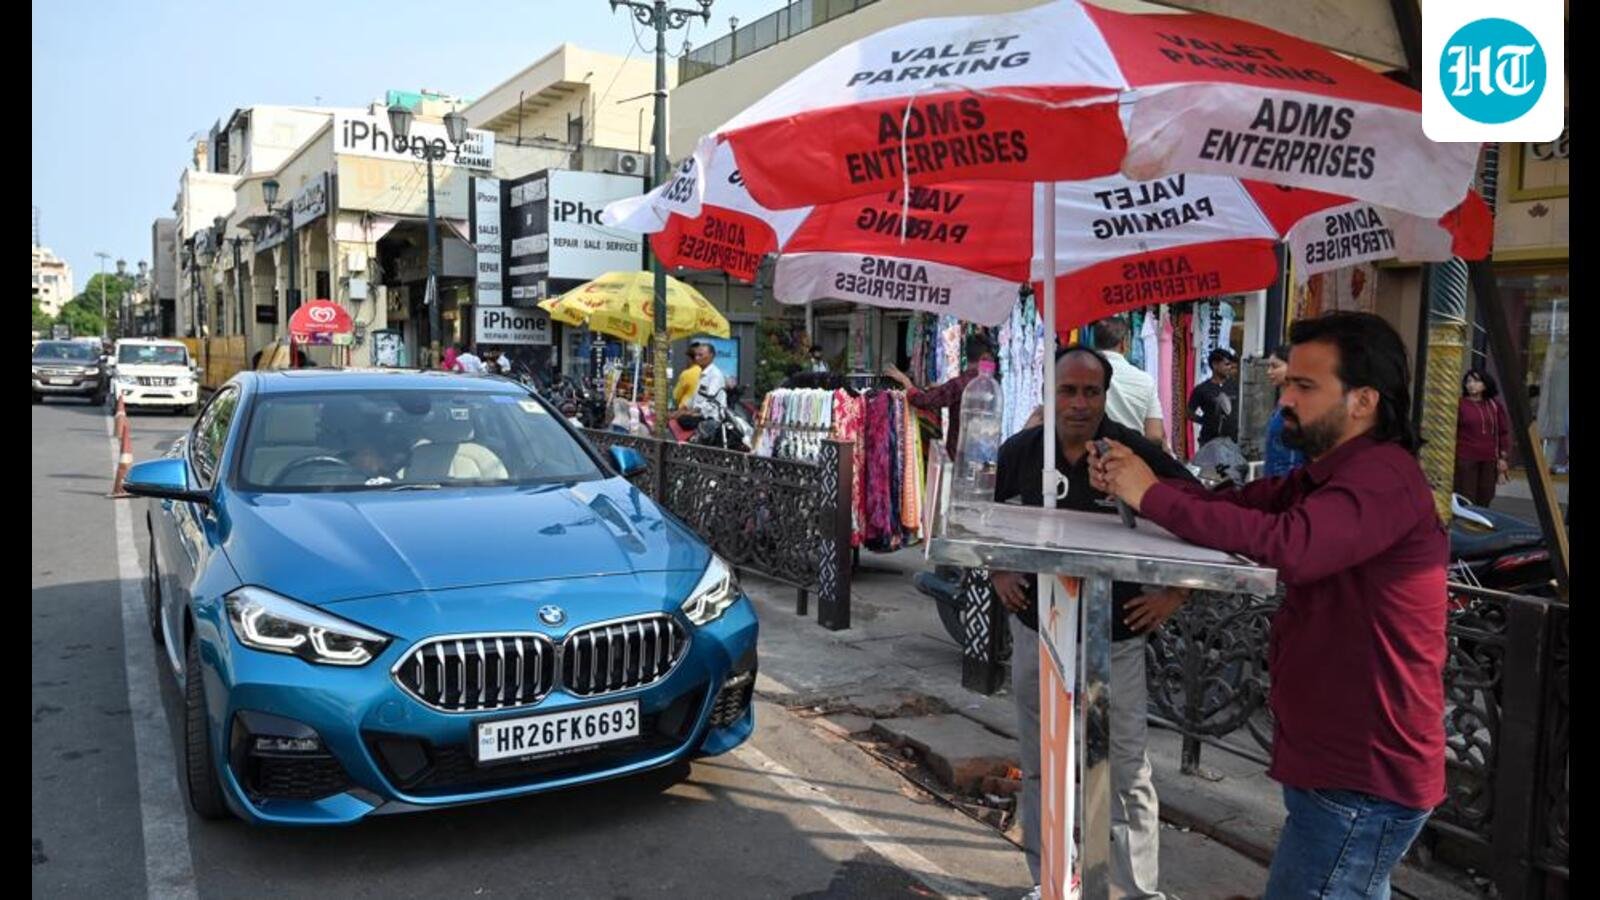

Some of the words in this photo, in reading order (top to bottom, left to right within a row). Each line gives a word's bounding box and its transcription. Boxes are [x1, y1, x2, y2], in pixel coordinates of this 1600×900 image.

[846, 52, 1031, 87] PARKING
[891, 35, 1019, 64] VALET
[877, 98, 986, 144] ADMS
[1249, 98, 1355, 140] ADMS
[846, 129, 1029, 184] ENTERPRISES
[1199, 128, 1376, 180] ENTERPRISES
[554, 237, 578, 248] REPAIR
[606, 241, 638, 253] SERVICES
[483, 311, 546, 331] iPhone
[497, 707, 637, 753] HR26FK6693
